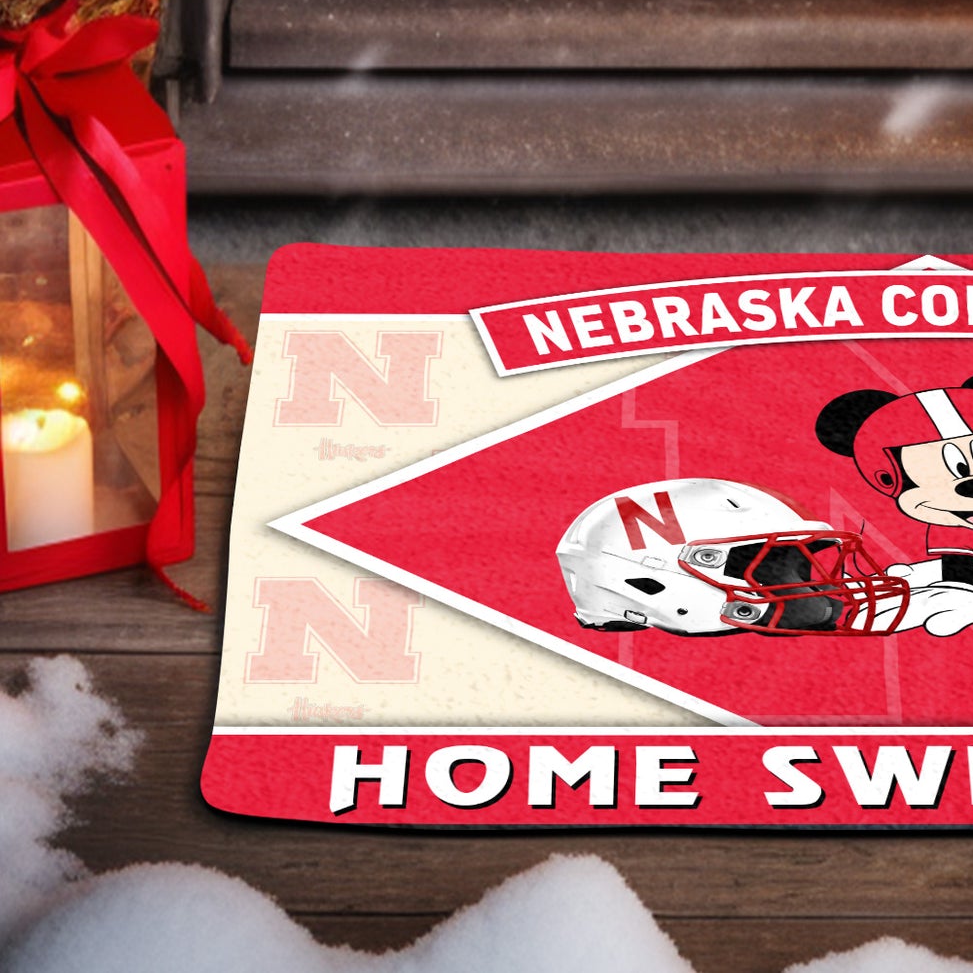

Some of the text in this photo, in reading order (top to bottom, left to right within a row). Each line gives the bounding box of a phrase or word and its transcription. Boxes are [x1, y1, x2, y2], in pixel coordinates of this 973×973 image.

[522, 284, 864, 356] NEBRASKA
[274, 330, 443, 428] N
[616, 491, 687, 550] N
[243, 577, 425, 685] N
[329, 744, 703, 816] HOME
